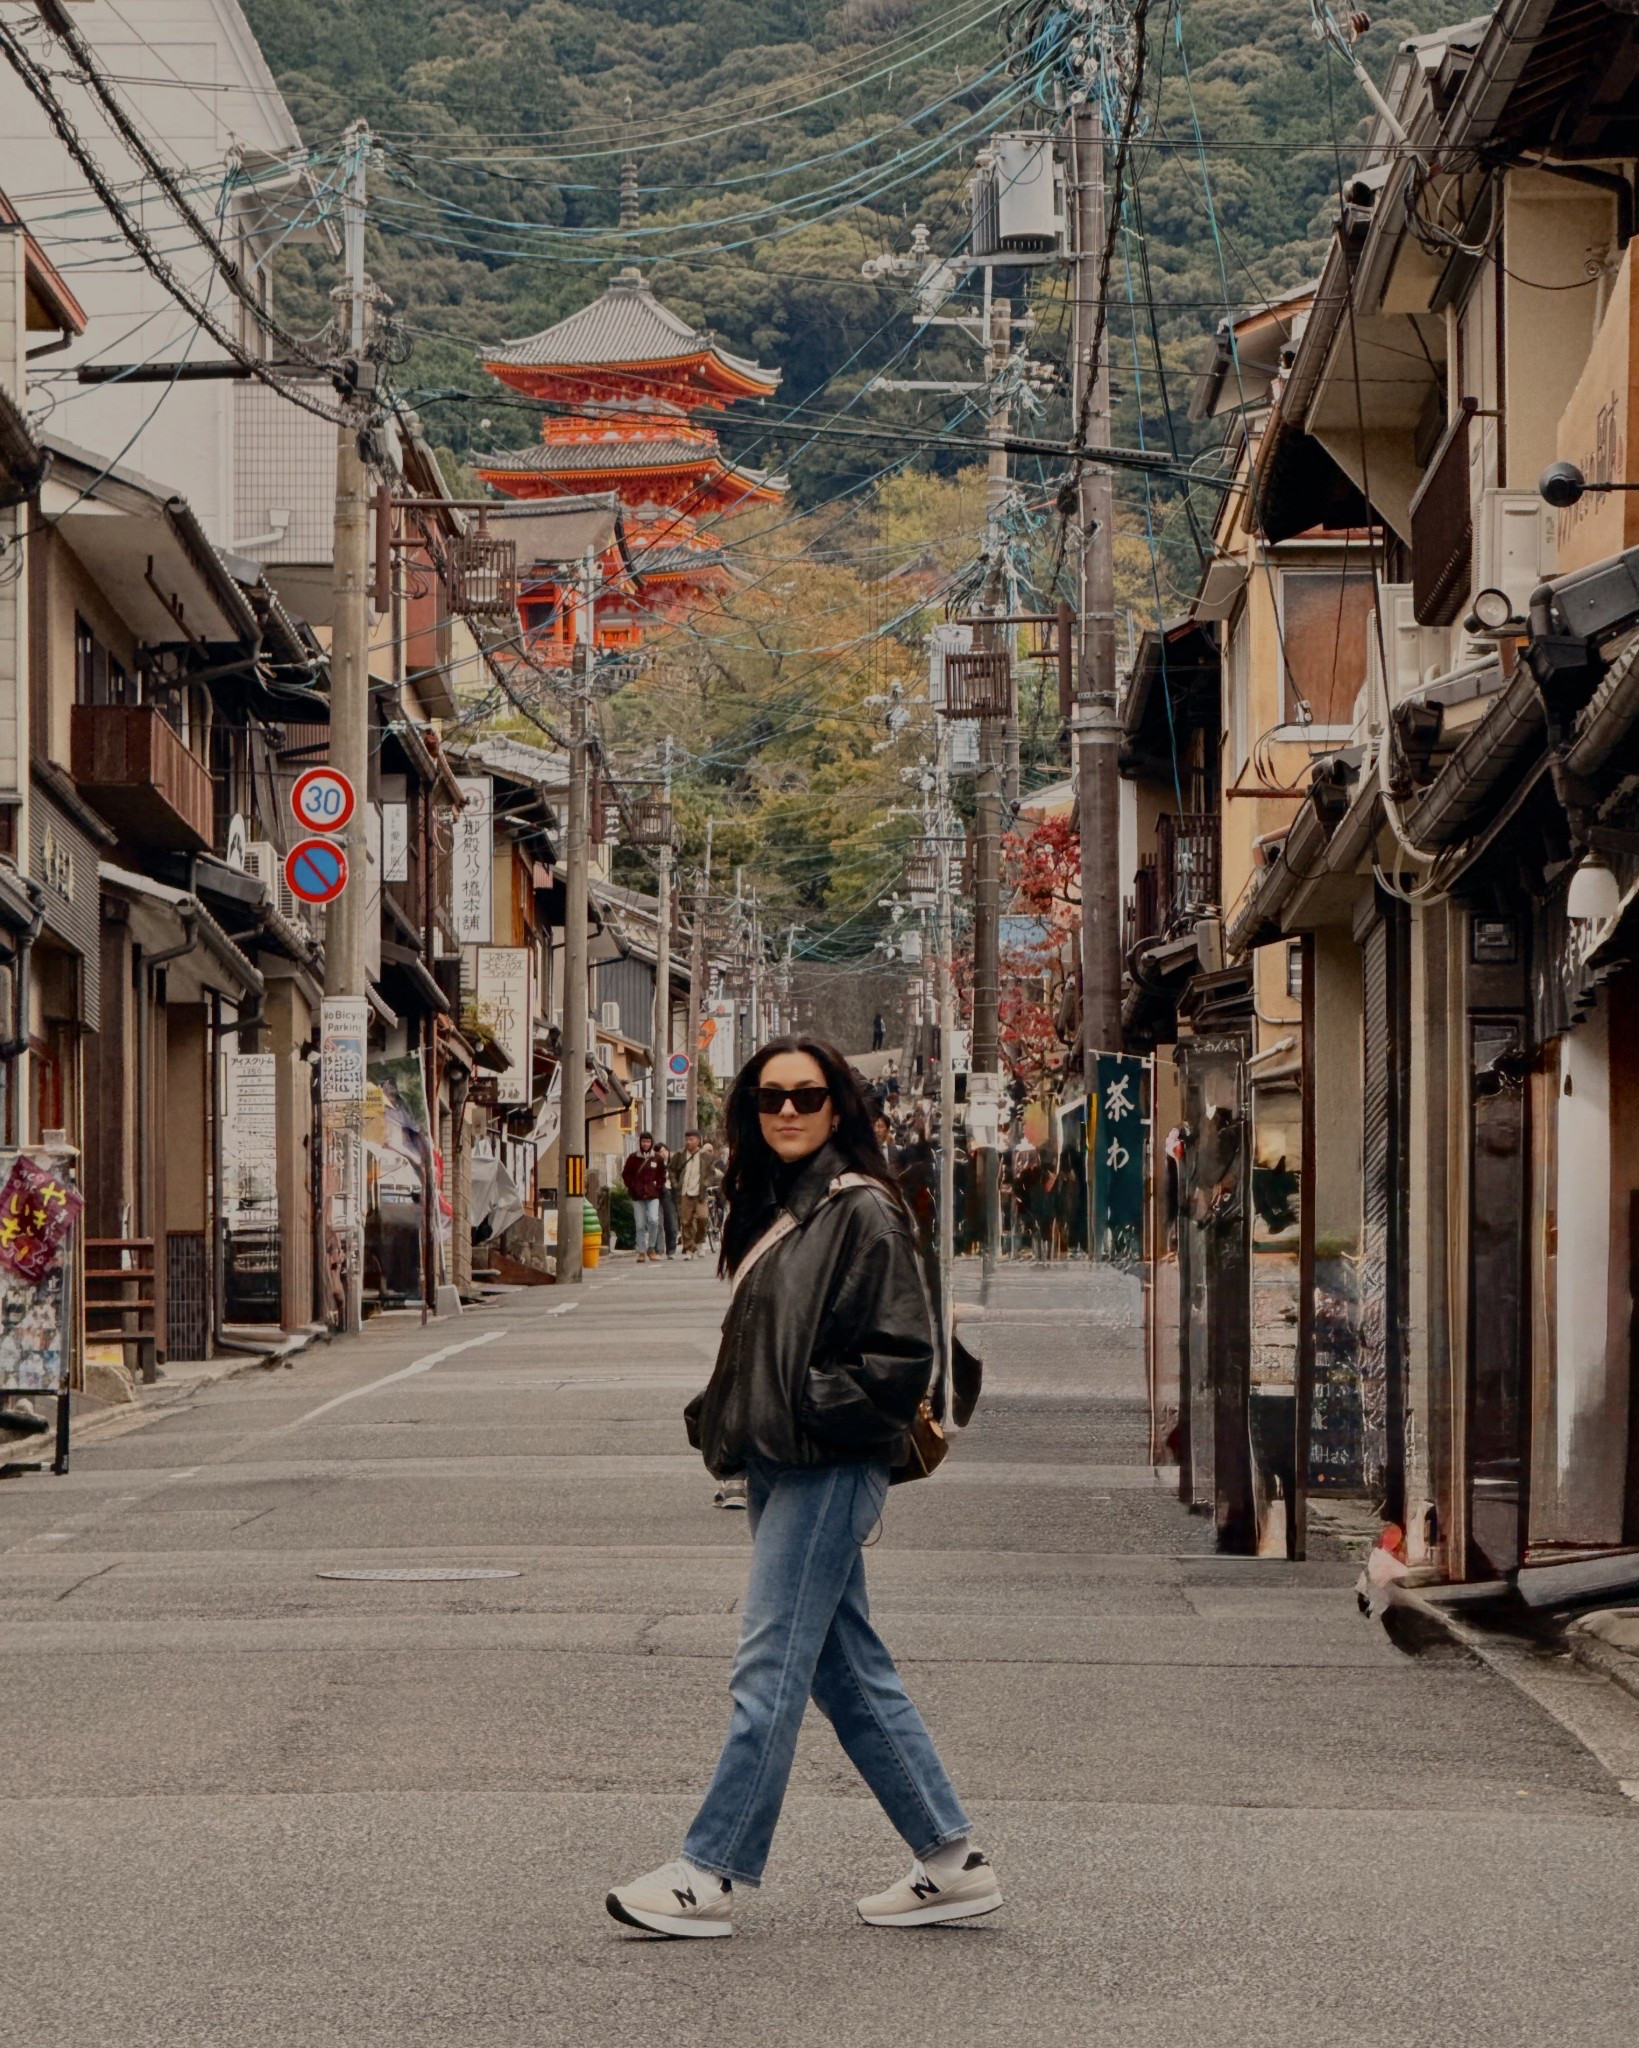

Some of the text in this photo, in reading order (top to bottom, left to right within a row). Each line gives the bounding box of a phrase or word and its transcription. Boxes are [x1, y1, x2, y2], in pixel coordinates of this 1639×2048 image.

[305, 785, 341, 816] 30
[231, 1057, 274, 1066] アイスクリーム
